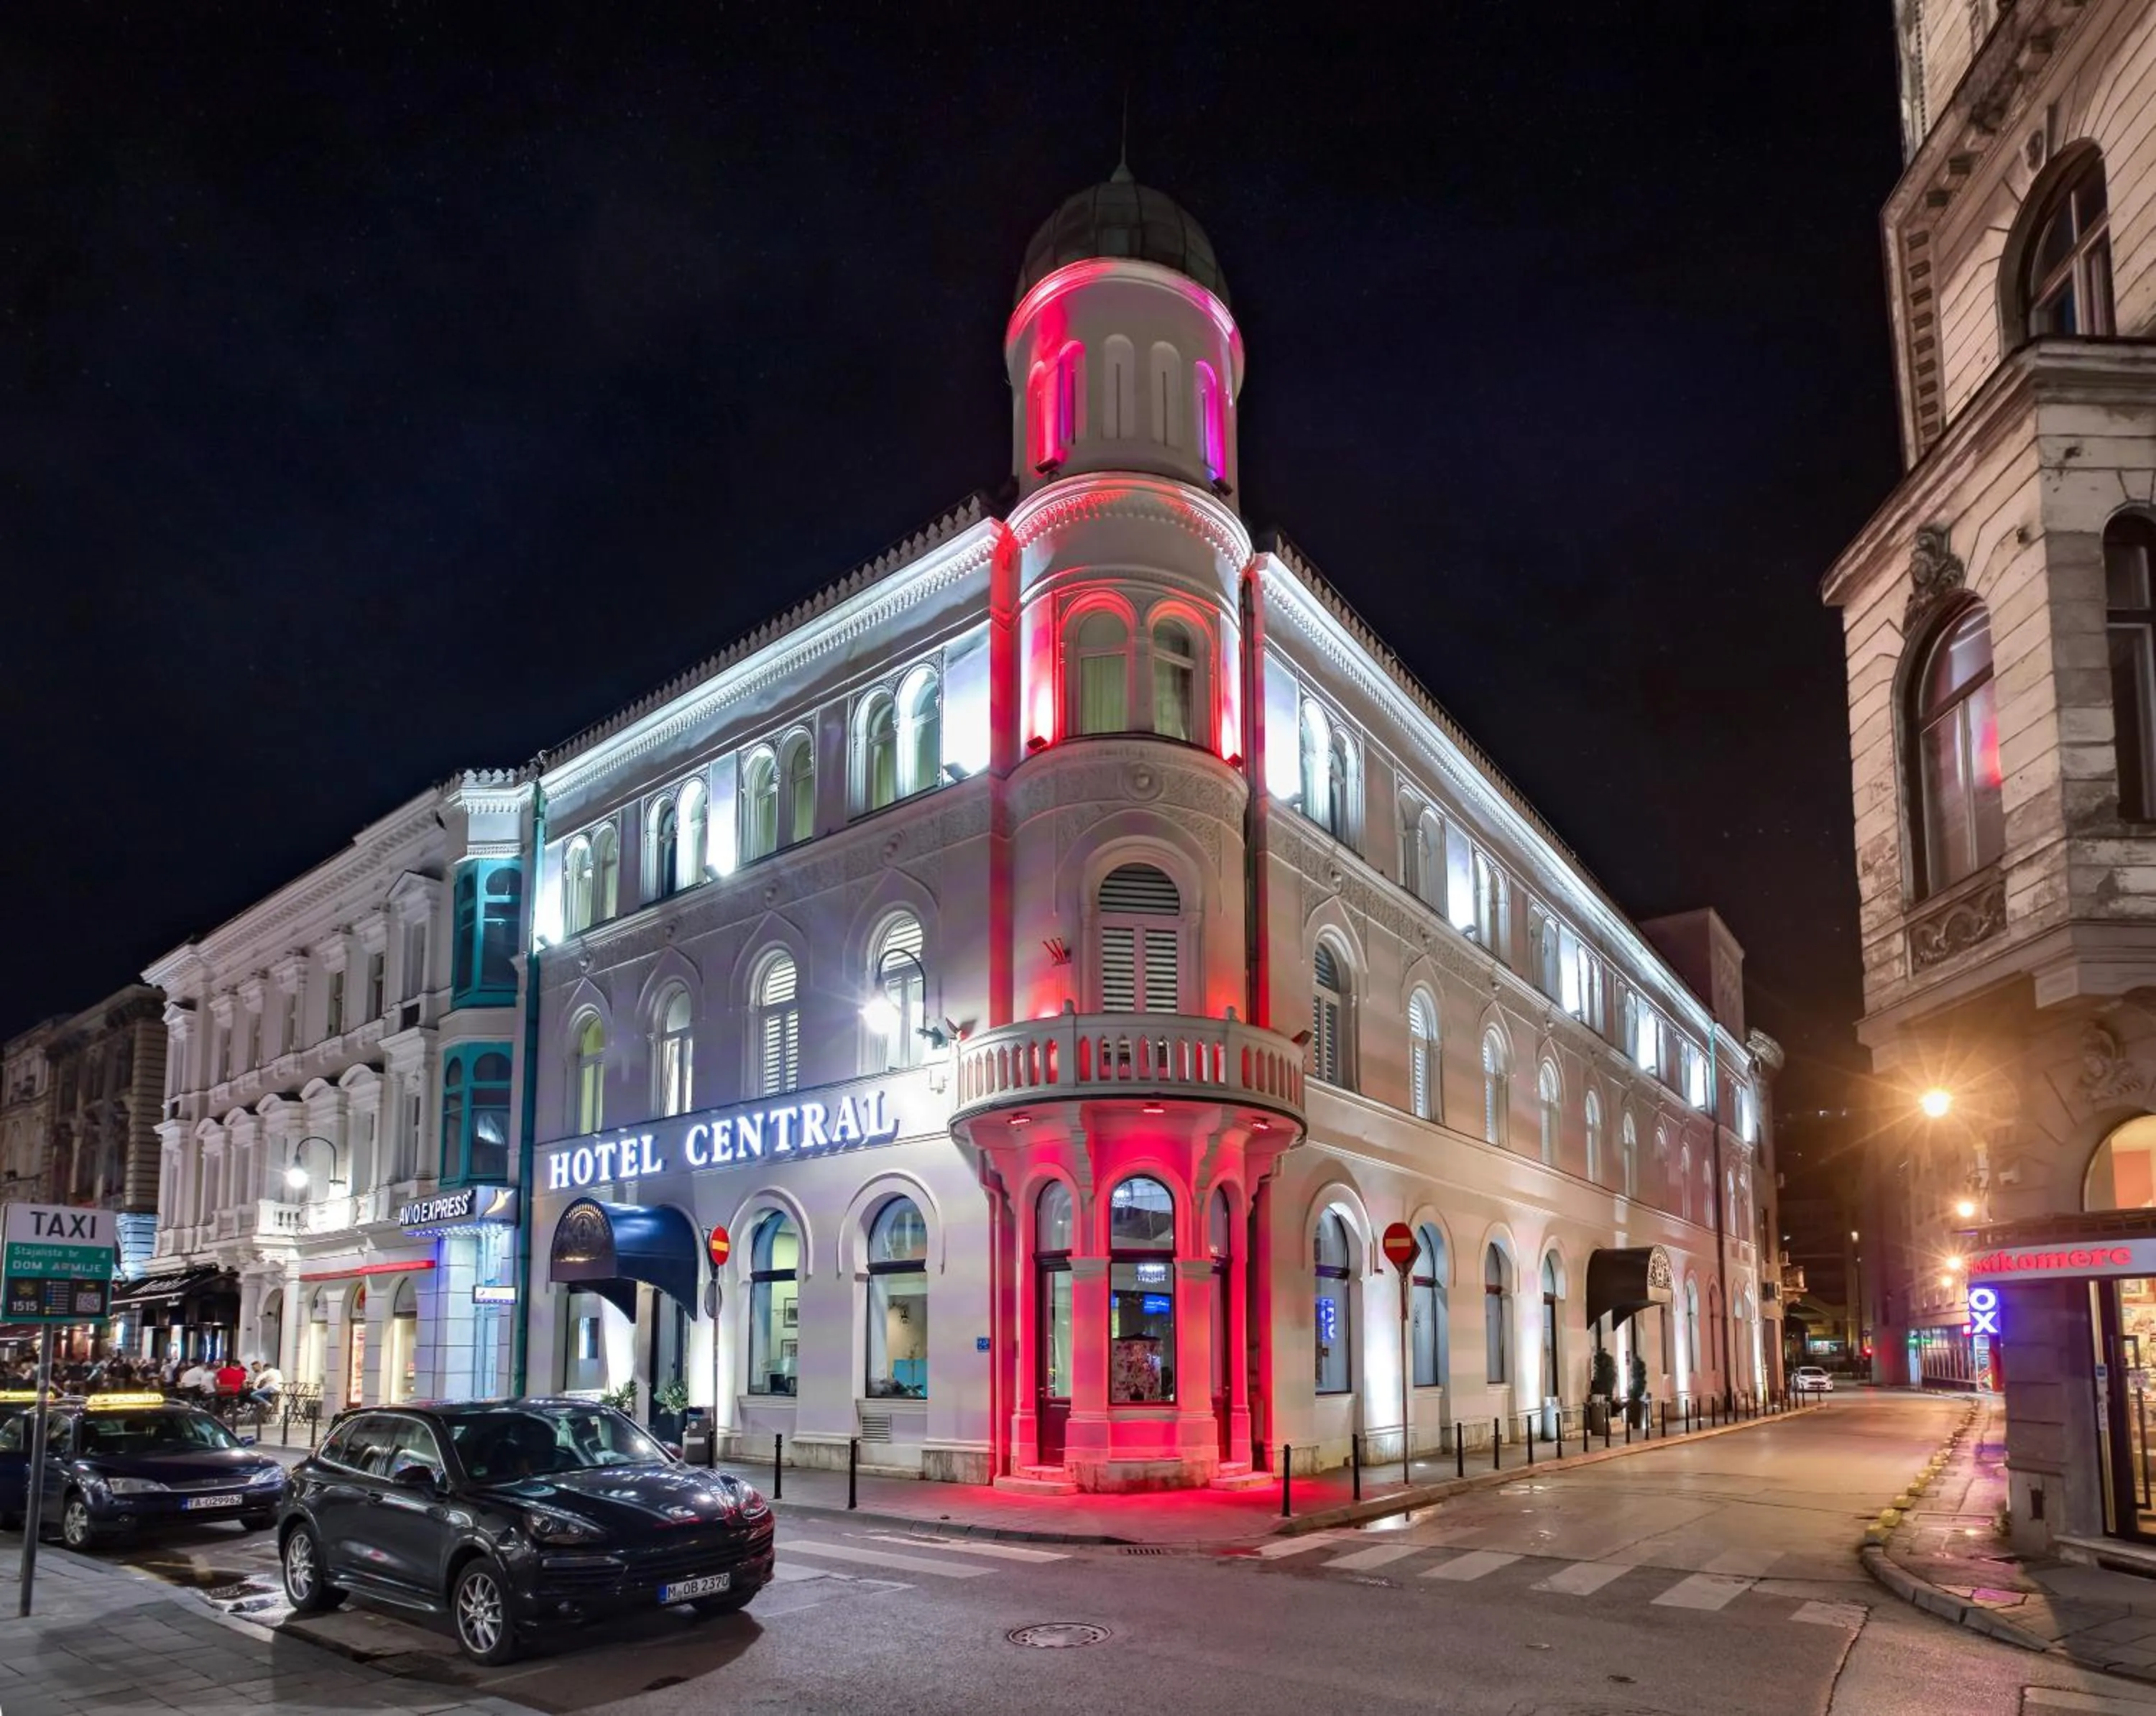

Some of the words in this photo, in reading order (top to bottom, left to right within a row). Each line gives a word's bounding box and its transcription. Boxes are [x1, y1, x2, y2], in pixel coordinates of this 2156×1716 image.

[549, 1135, 663, 1189] HOTEL
[685, 1091, 898, 1166] CENTRAL
[29, 1211, 98, 1239] TAXI
[12, 1260, 43, 1270] DOM
[52, 1262, 102, 1273] ARMIJE
[11, 1300, 37, 1312] 1515
[683, 1581, 699, 1595] OB
[702, 1574, 728, 1591] 2370
